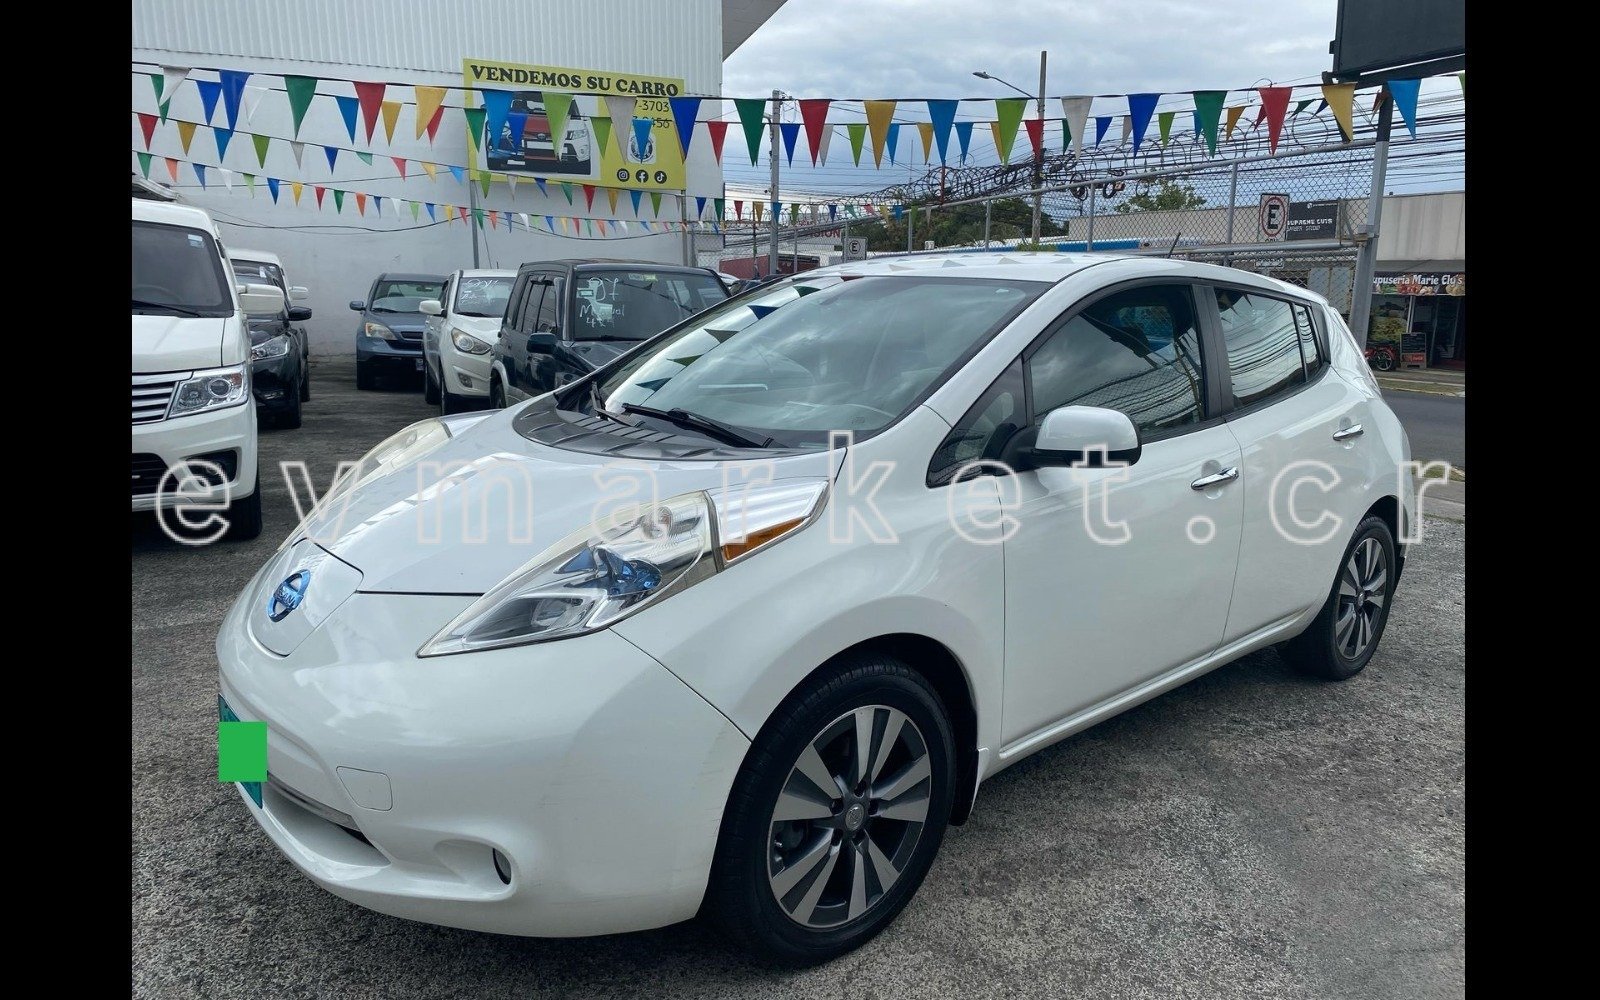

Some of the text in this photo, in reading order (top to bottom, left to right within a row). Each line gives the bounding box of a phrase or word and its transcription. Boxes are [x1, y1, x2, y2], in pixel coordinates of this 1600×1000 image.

[470, 65, 679, 98] VENDEMOS SU CARRO
[1267, 204, 1280, 229] E
[851, 242, 858, 252] E
[1411, 274, 1439, 285] Marie
